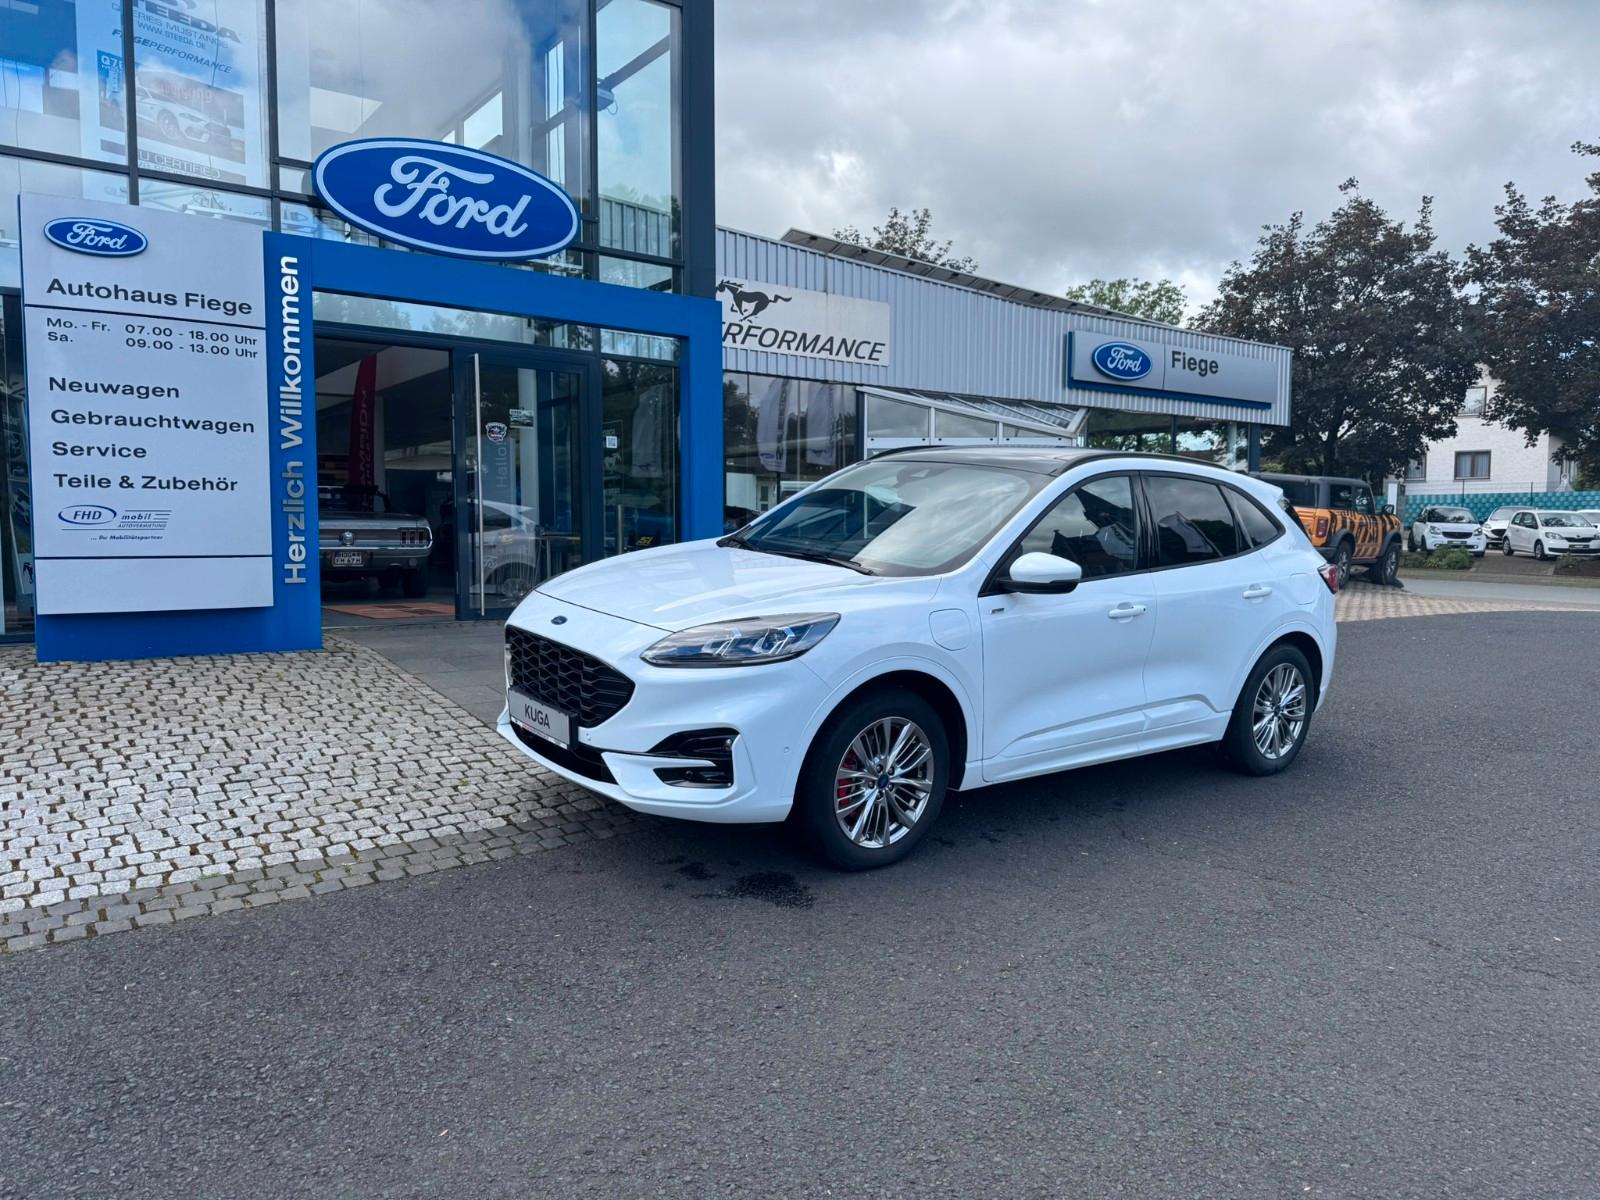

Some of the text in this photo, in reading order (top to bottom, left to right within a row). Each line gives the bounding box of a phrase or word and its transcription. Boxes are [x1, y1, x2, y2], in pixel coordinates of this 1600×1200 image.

[112, 28, 233, 74] FGEPERFORMANCE
[374, 155, 532, 238] Ford
[66, 223, 128, 249] Ford
[46, 278, 252, 316] Autohaus Fiege
[48, 331, 74, 343] Sa.
[125, 337, 173, 351] 09.00
[190, 343, 230, 357] 13.00
[235, 347, 258, 359] Uhr
[125, 323, 173, 338] 07.00
[189, 330, 230, 344] 18.00
[235, 334, 258, 346] Uhr
[722, 320, 887, 362] RFORMANCE
[1107, 346, 1143, 373] Ford
[1171, 350, 1219, 377] Fiege
[49, 377, 180, 399] Neuwagen
[51, 409, 255, 434] Gebrauchtwagen
[280, 256, 307, 584] Herzlich Willkommen
[52, 441, 147, 459] Service
[54, 473, 238, 492] Teile & Zubehör
[73, 510, 102, 520] FHD
[121, 513, 152, 521] mobil
[524, 703, 551, 730] KUGA
